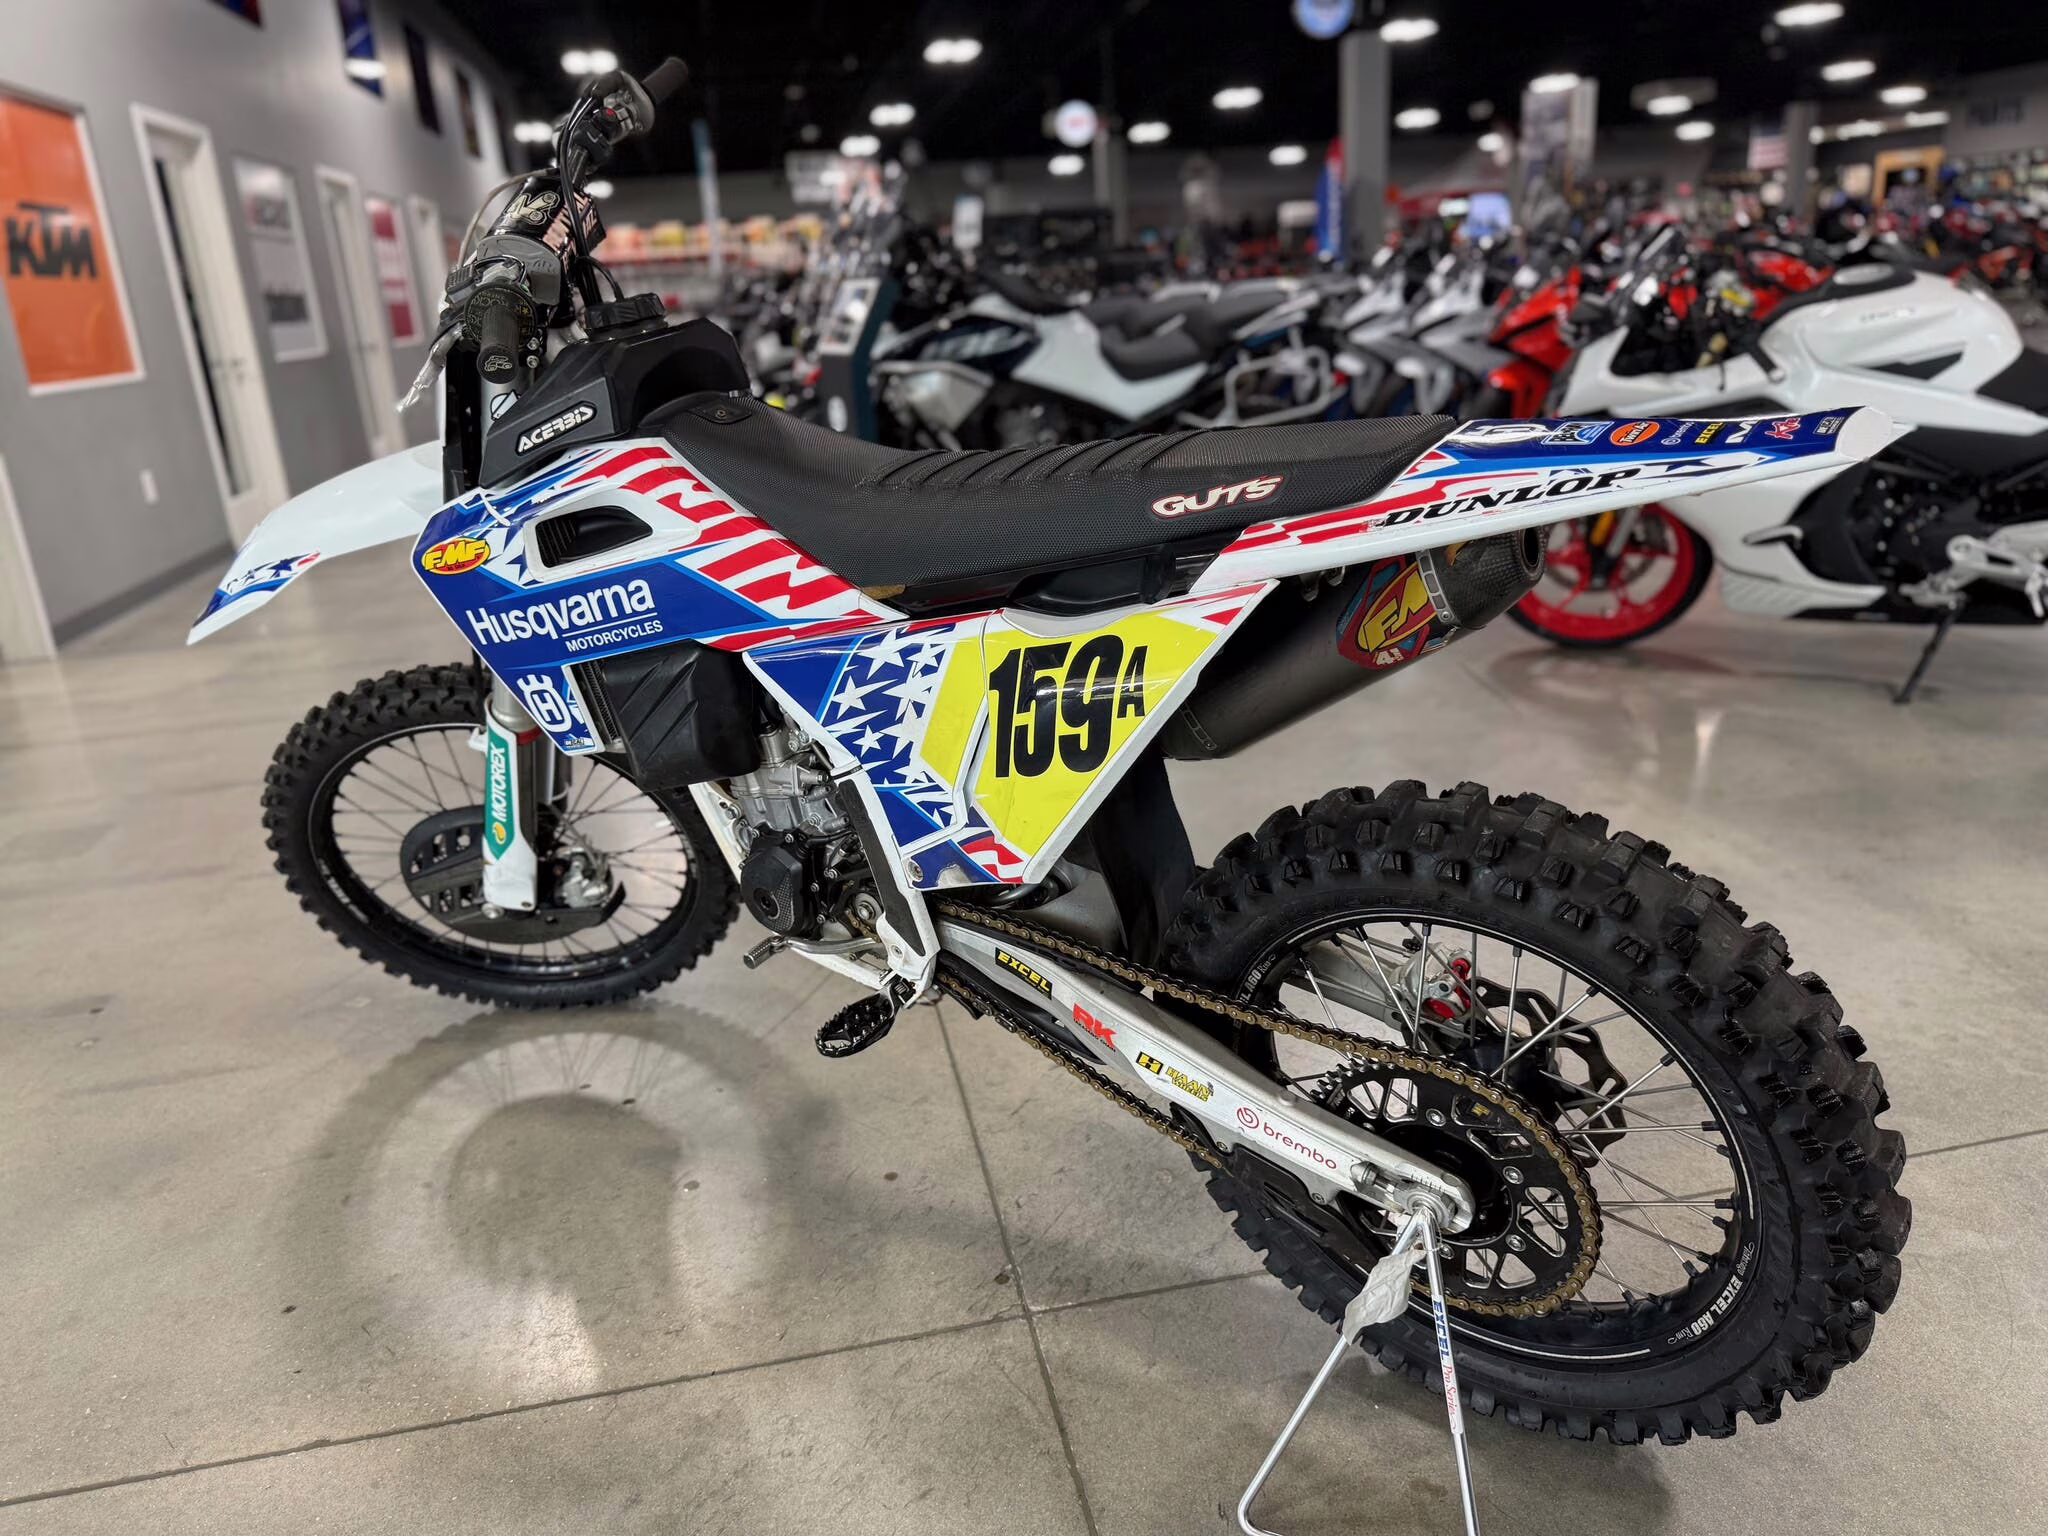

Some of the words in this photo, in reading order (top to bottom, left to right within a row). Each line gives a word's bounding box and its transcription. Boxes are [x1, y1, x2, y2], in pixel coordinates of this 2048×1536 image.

[6, 201, 97, 278] KTM
[1695, 421, 1725, 444] EXCEL
[1152, 477, 1284, 517] GUTS
[1378, 468, 1641, 527] DUNLOP
[425, 540, 486, 571] FMF
[466, 578, 656, 646] Husqvarna
[565, 620, 664, 653] MOTORCYCLES
[490, 741, 507, 823] MOTOREX
[998, 951, 1050, 992] EXCEL
[1073, 1003, 1117, 1050] RK
[1165, 1066, 1212, 1096] HAAN
[1263, 1122, 1337, 1170] brembo
[1710, 1275, 1743, 1315] EXCEL
[1433, 1300, 1450, 1361] EXCEL
[1691, 1311, 1715, 1336] A60
